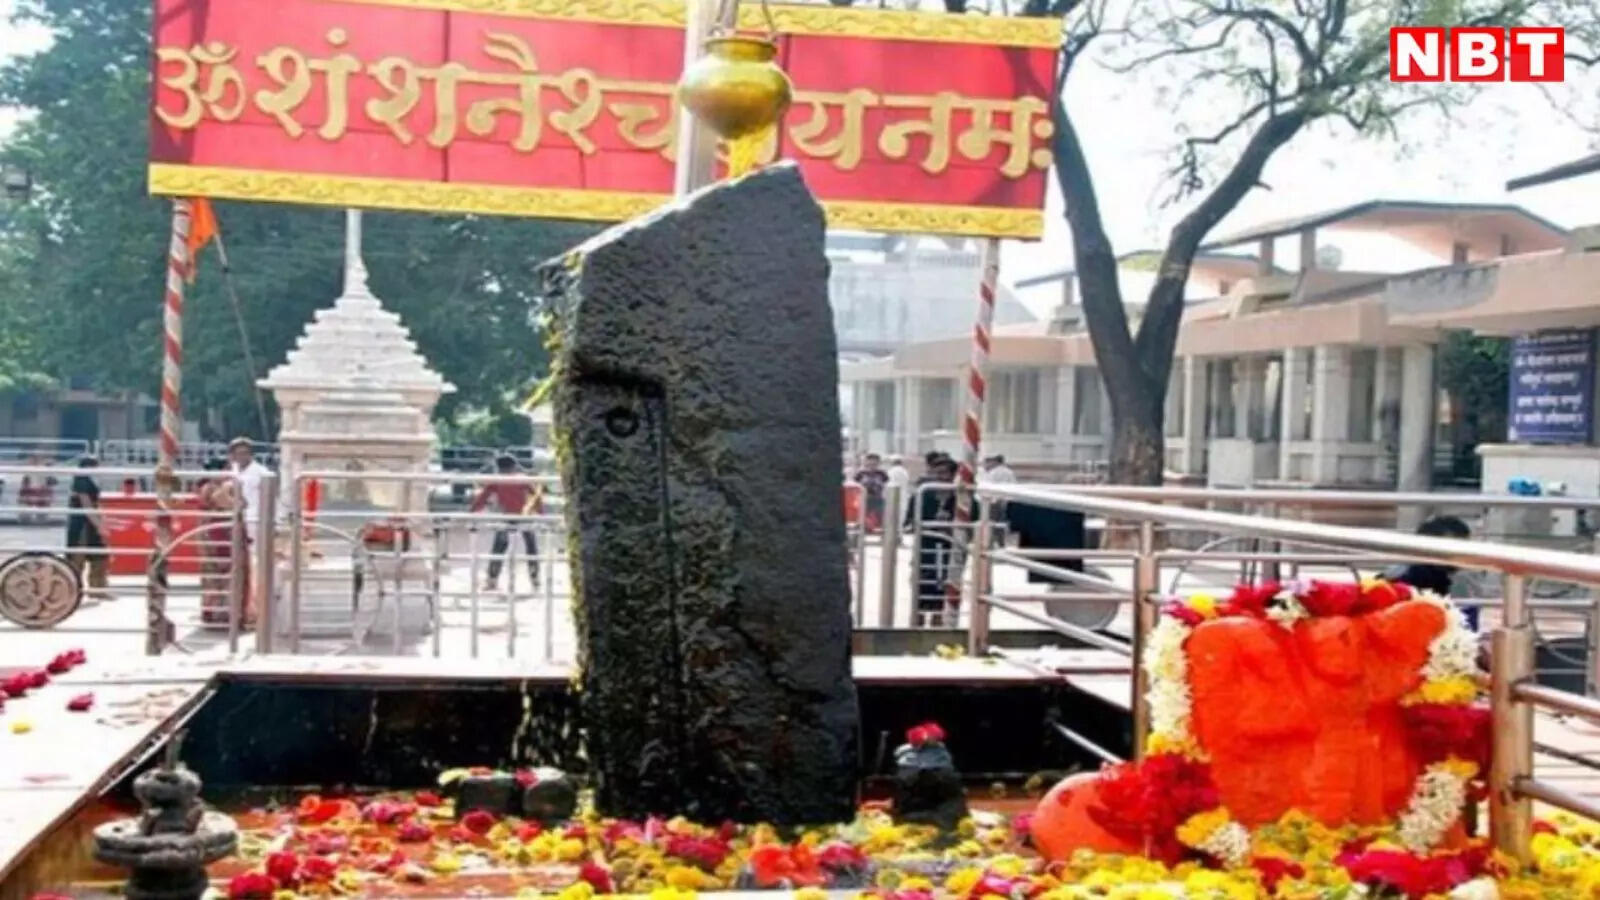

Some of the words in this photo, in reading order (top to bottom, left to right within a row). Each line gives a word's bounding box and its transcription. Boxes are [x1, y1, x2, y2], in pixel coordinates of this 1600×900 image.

[156, 41, 246, 129] ॐ
[253, 28, 361, 140] शं
[879, 91, 1055, 179] नमः
